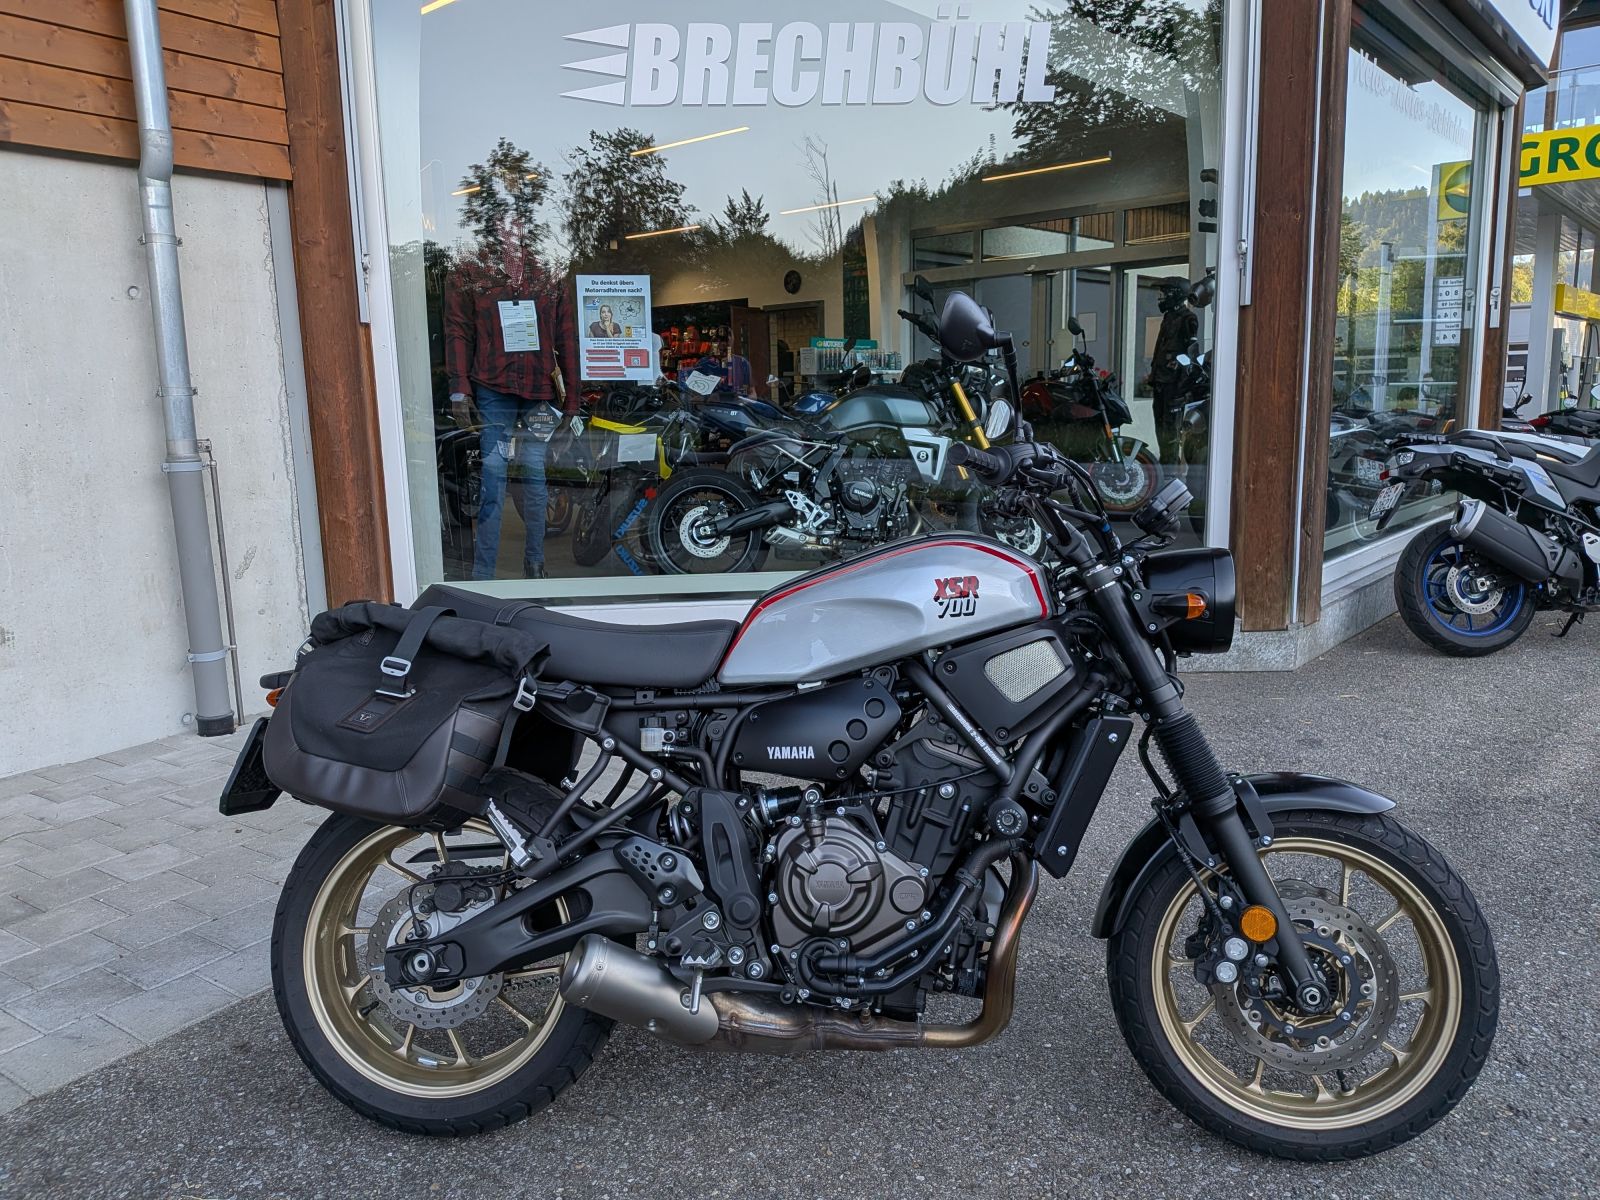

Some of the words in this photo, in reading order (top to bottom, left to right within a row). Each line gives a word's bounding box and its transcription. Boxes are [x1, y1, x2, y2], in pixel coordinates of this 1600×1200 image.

[630, 4, 1056, 107] BRECHBÜHL
[919, 450, 927, 460] 8
[853, 488, 873, 499] SUZUKI
[933, 575, 979, 602] XSR
[938, 598, 976, 618] 700
[766, 746, 815, 759] YAMAHA
